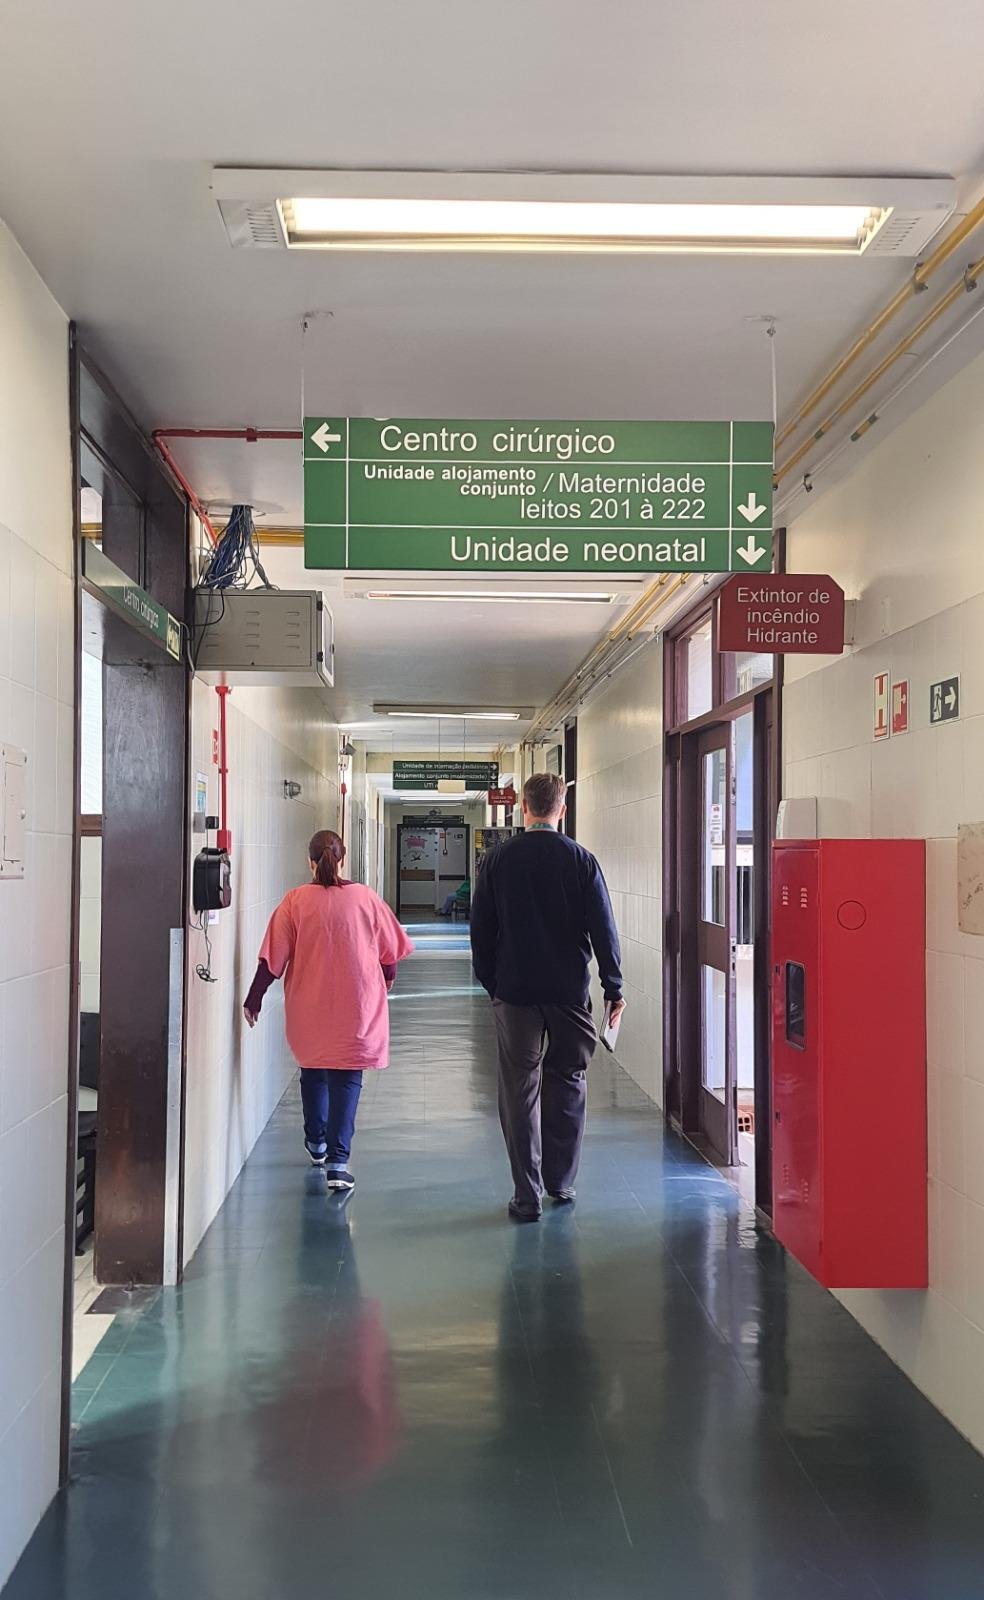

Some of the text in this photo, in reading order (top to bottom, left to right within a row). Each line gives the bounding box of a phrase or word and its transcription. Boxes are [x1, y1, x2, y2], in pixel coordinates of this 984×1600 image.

[379, 424, 616, 460] Centro cirúrgico
[363, 464, 537, 485] Unidade alojamento
[542, 472, 706, 494] / Maternidade
[460, 480, 537, 499] conjunto
[520, 498, 706, 520] leitos 201 à 222
[450, 535, 706, 563] Unidade neonatal
[737, 586, 831, 604] Extintor de
[747, 607, 820, 625] incêndio
[747, 627, 818, 645] Hidrante
